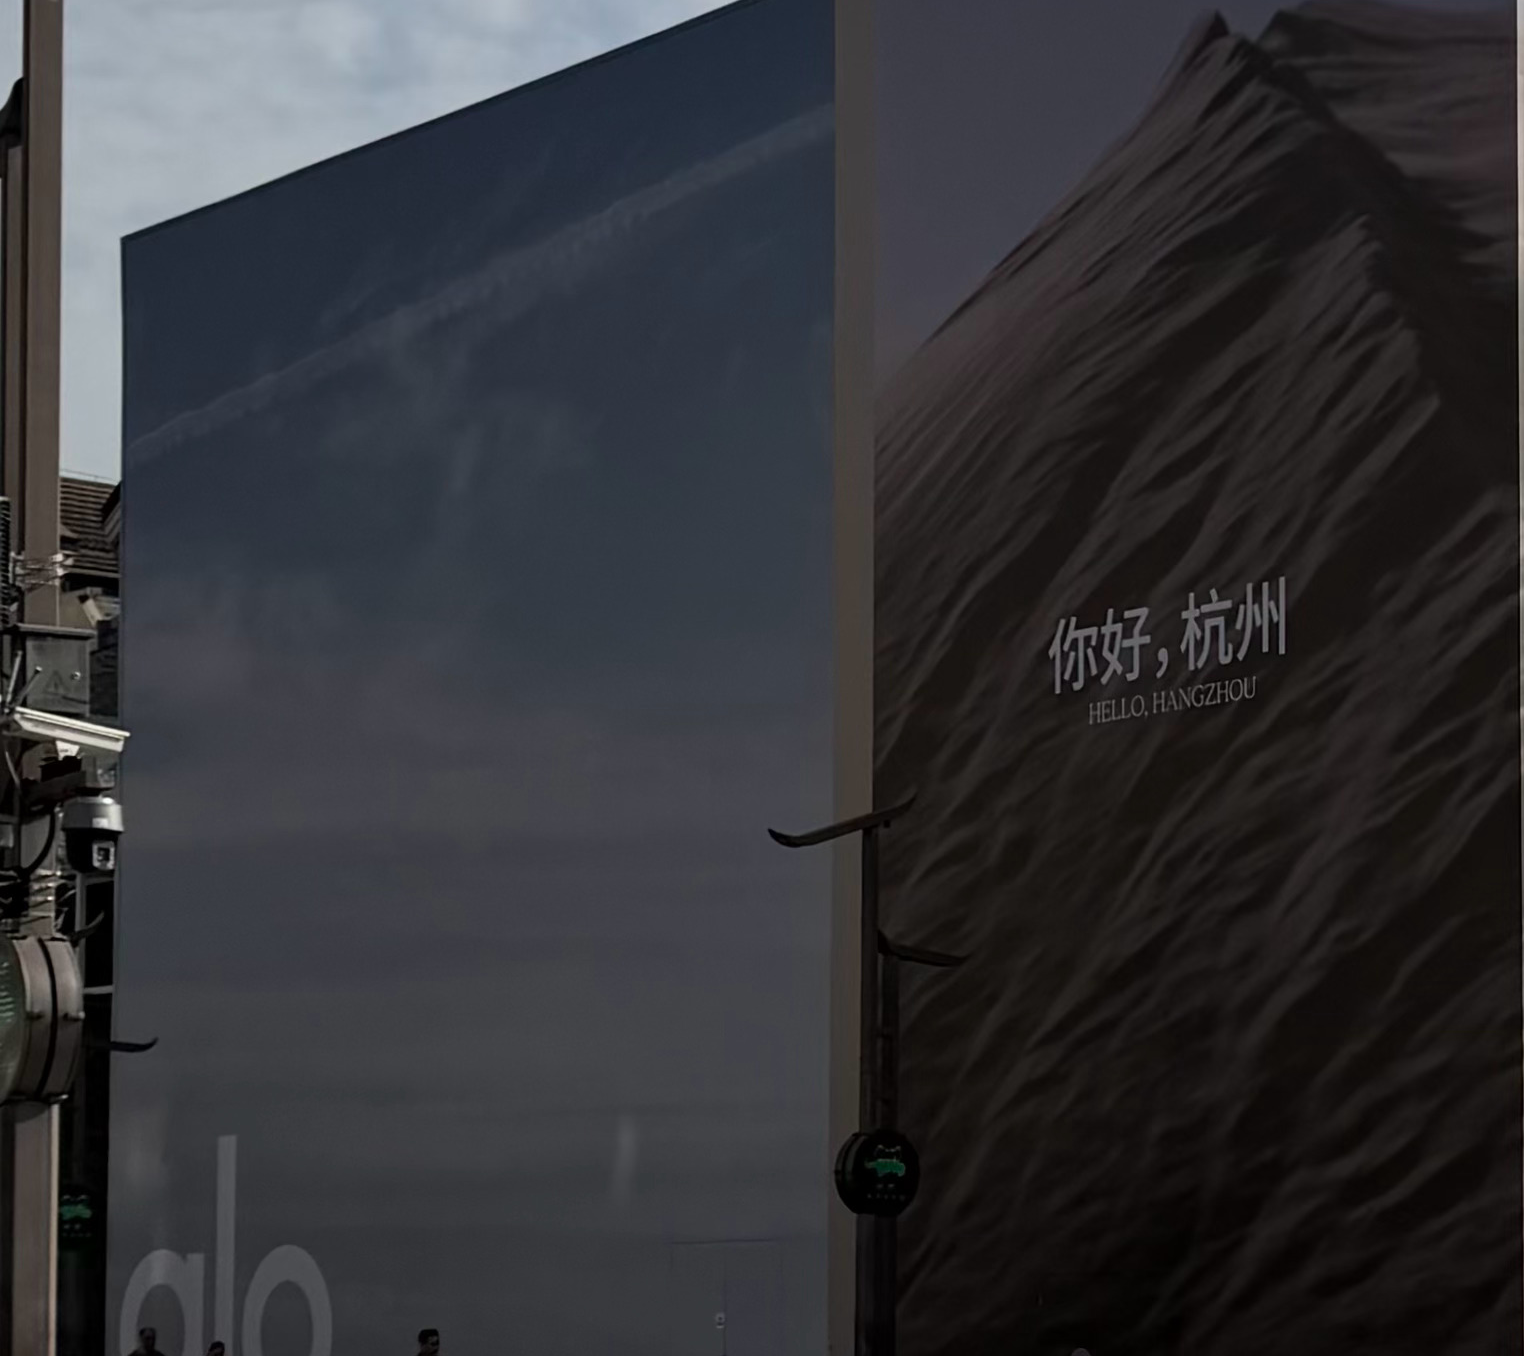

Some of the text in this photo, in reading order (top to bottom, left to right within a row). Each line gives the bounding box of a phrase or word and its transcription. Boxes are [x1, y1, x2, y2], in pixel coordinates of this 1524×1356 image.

[1048, 575, 1287, 695] 你好，杭州
[1088, 675, 1257, 725] HELLO, HANGZHOU
